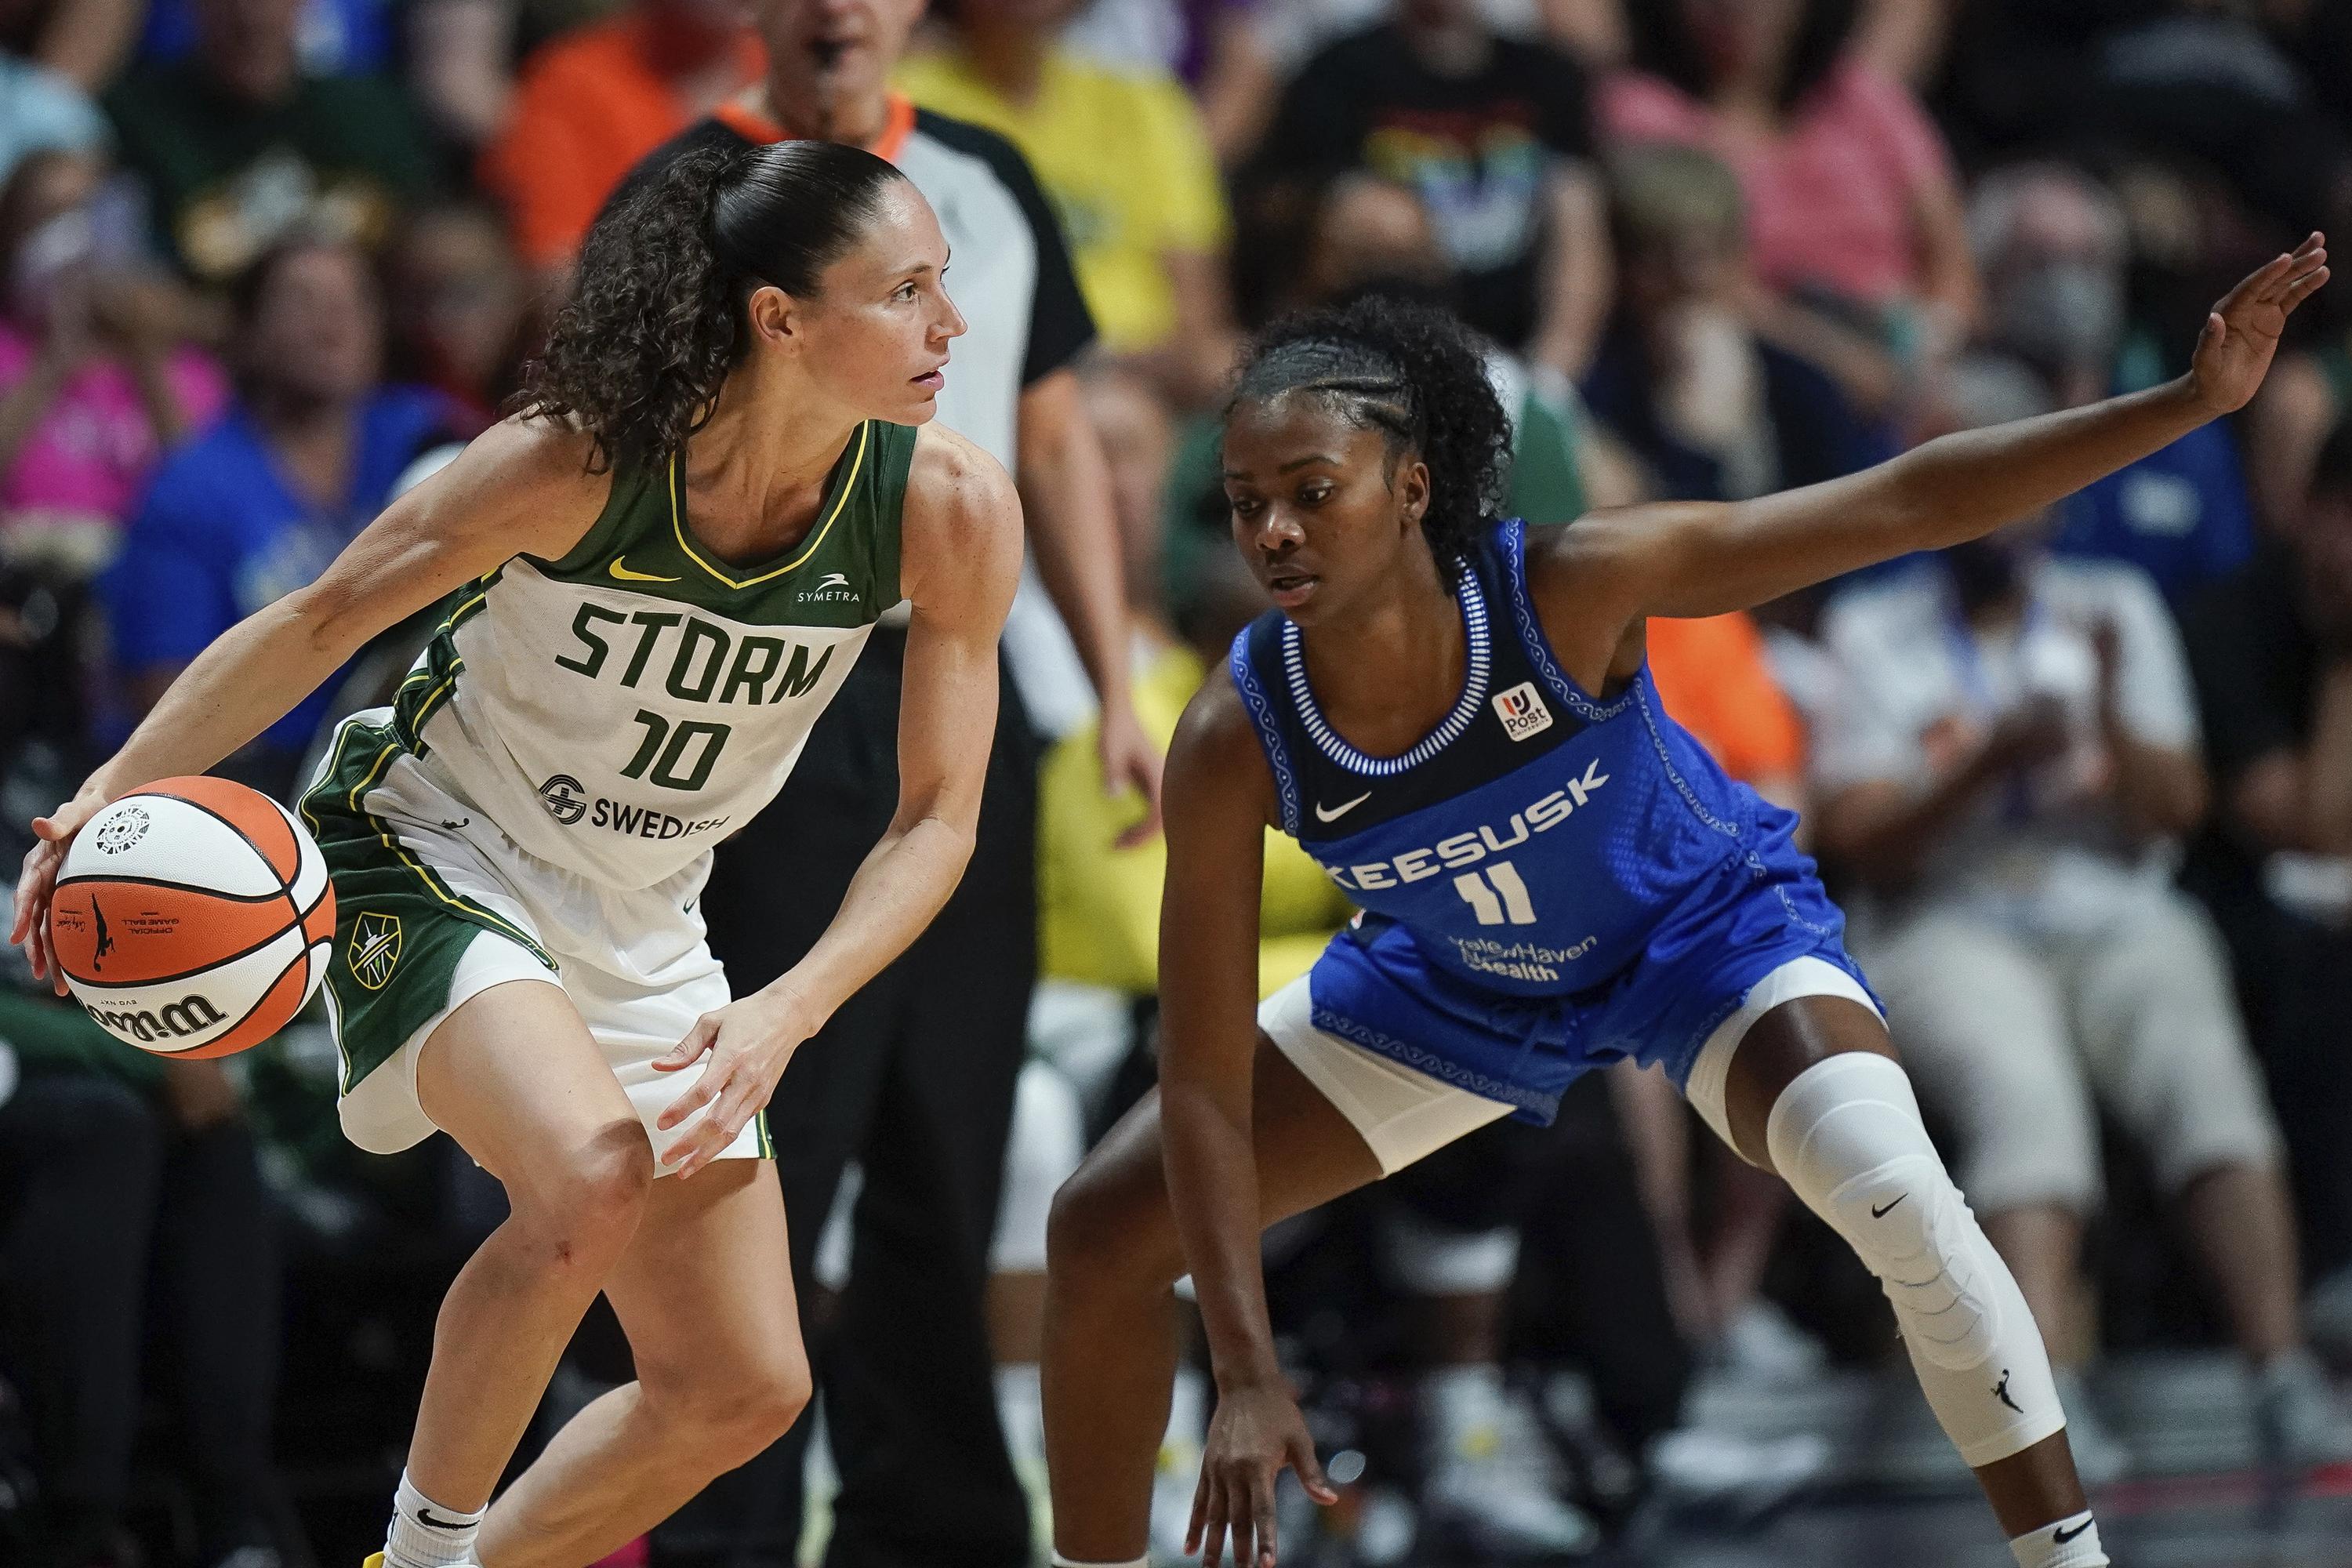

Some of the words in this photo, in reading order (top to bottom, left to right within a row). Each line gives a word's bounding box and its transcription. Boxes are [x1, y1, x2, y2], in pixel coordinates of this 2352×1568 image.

[797, 591, 860, 602] SYMETRA
[554, 602, 837, 705] STORM
[1505, 707, 1546, 732] Post
[619, 709, 732, 792] 10
[591, 798, 731, 840] SWEDISH
[1323, 757, 1610, 891] KEESUSK
[1454, 861, 1537, 926] 11
[76, 993, 230, 1043] Wilso
